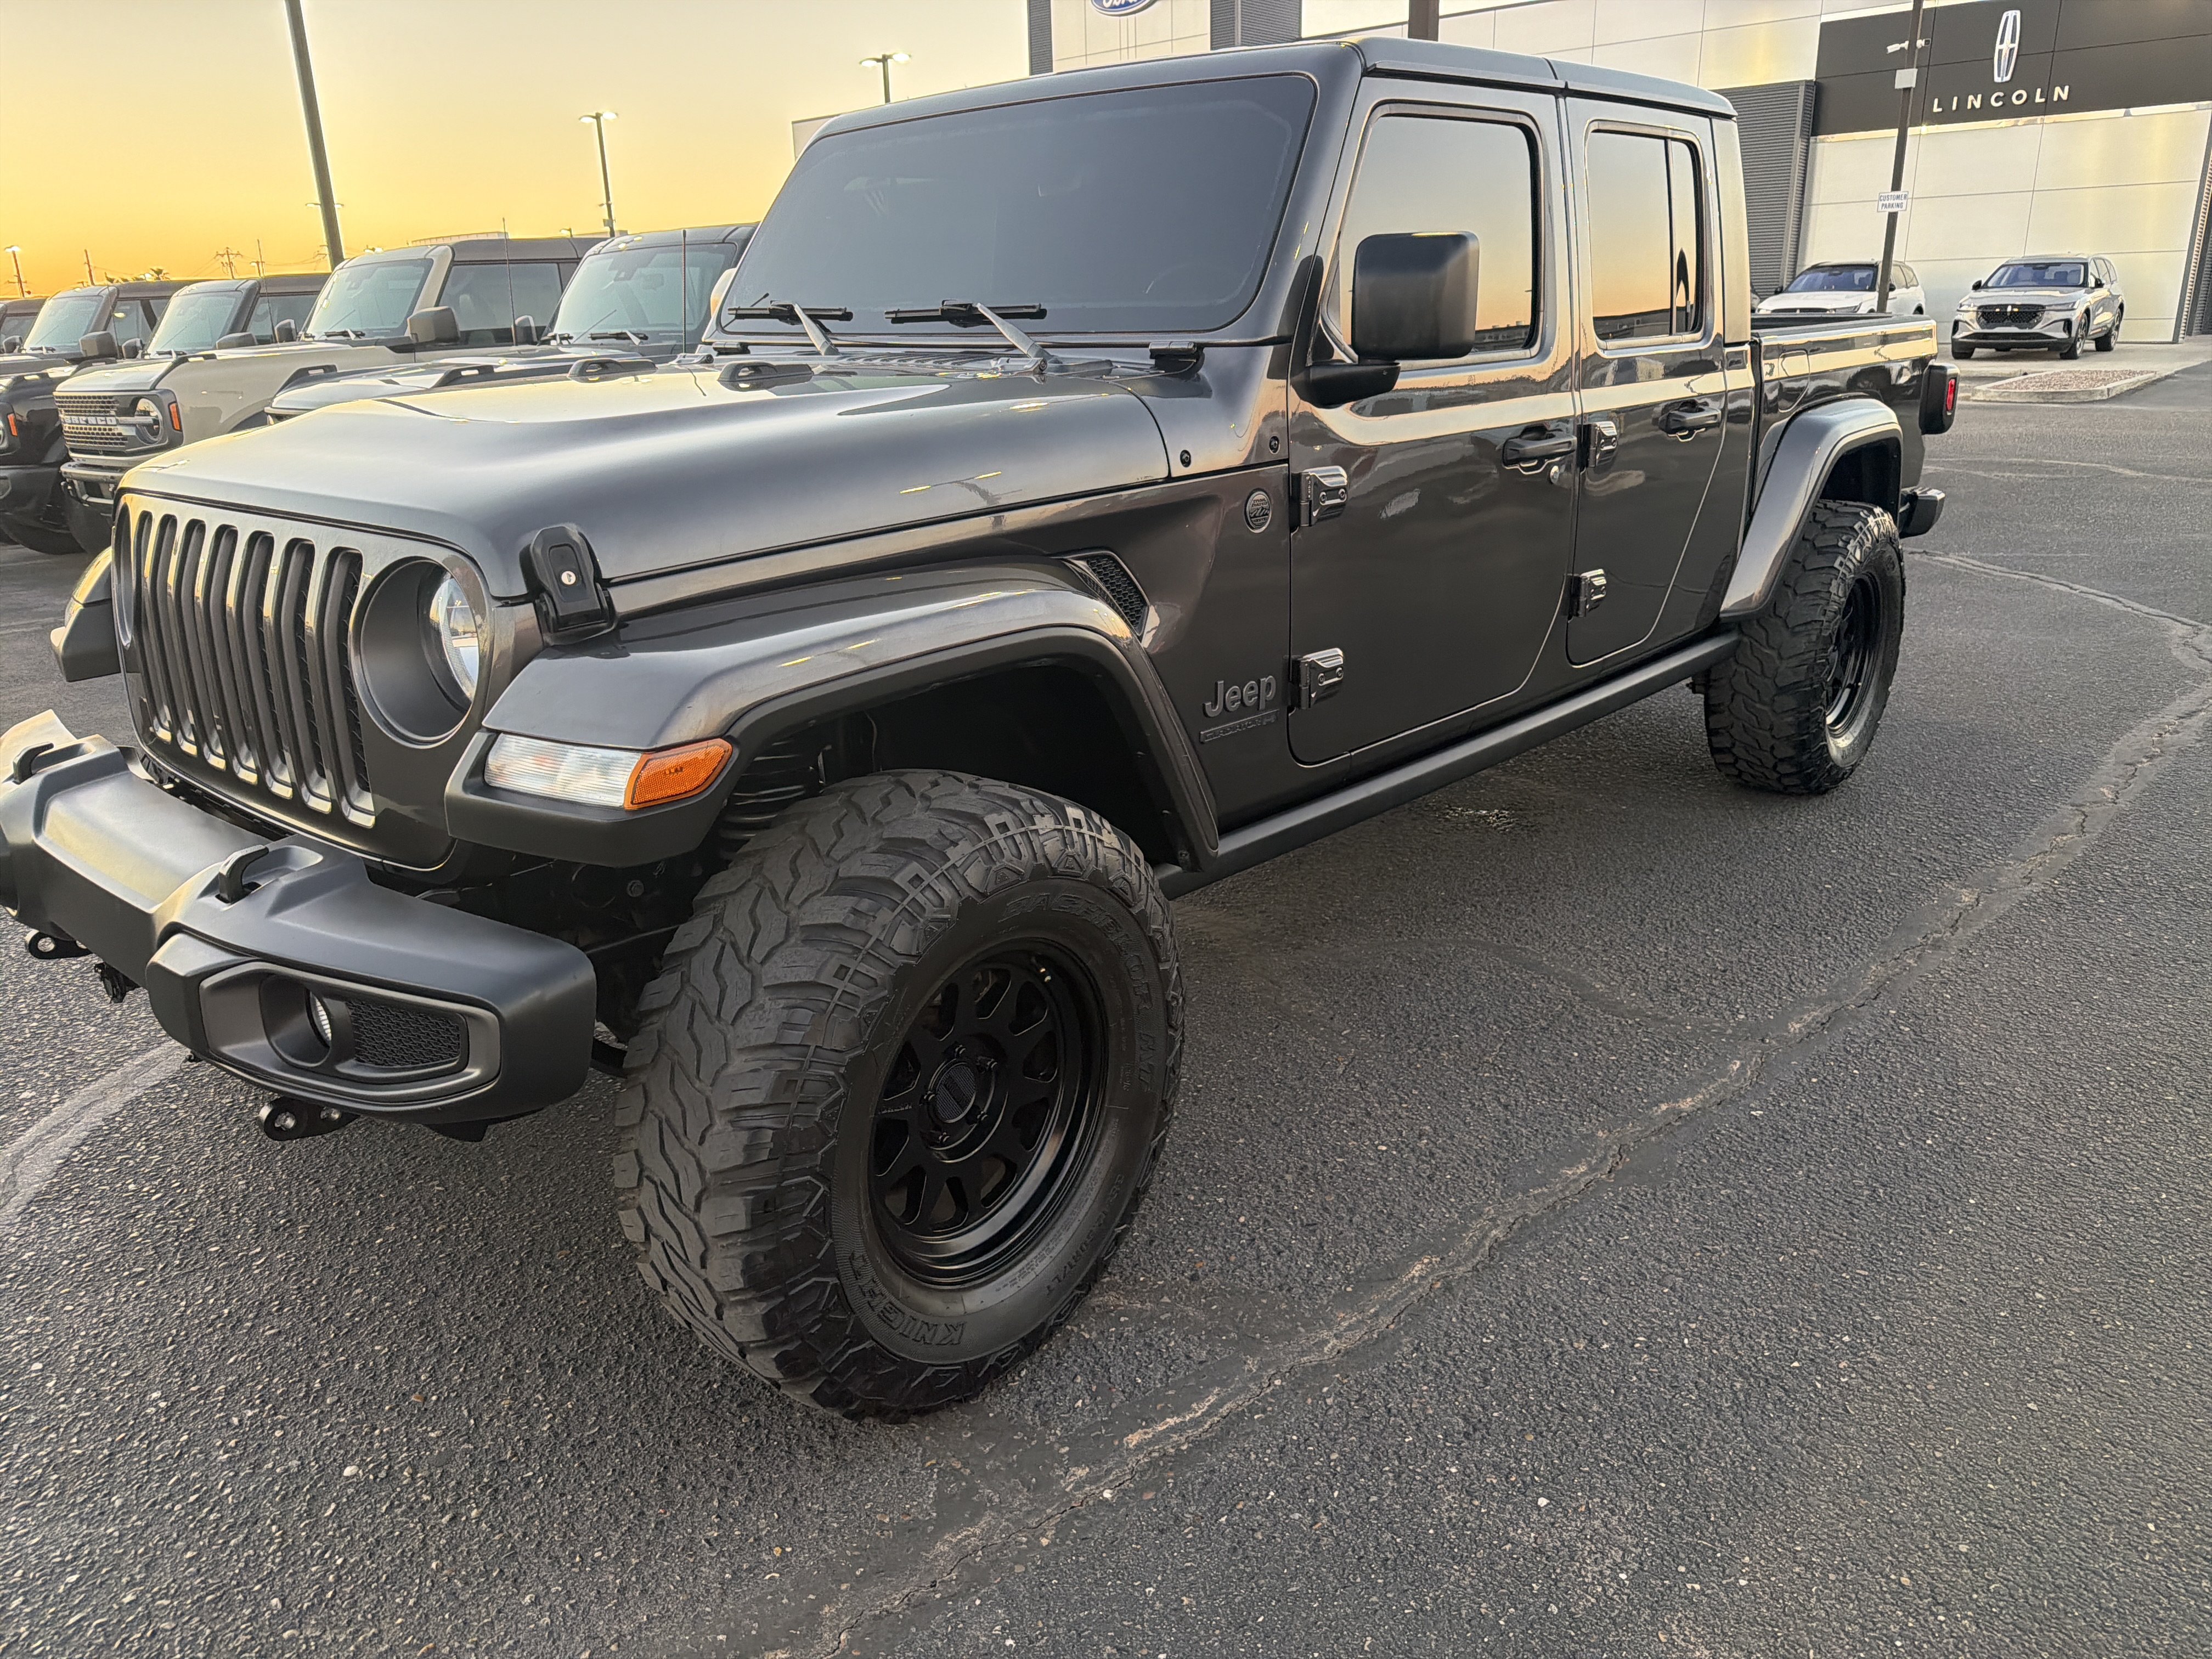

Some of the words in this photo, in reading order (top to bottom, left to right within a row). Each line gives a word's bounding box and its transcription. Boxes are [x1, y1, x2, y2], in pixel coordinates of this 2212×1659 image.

[1933, 85, 2069, 112] LINCOLN
[1879, 194, 1908, 202] CUSTOMER
[1881, 202, 1904, 210] PARKING
[1203, 675, 1276, 718] Jeep
